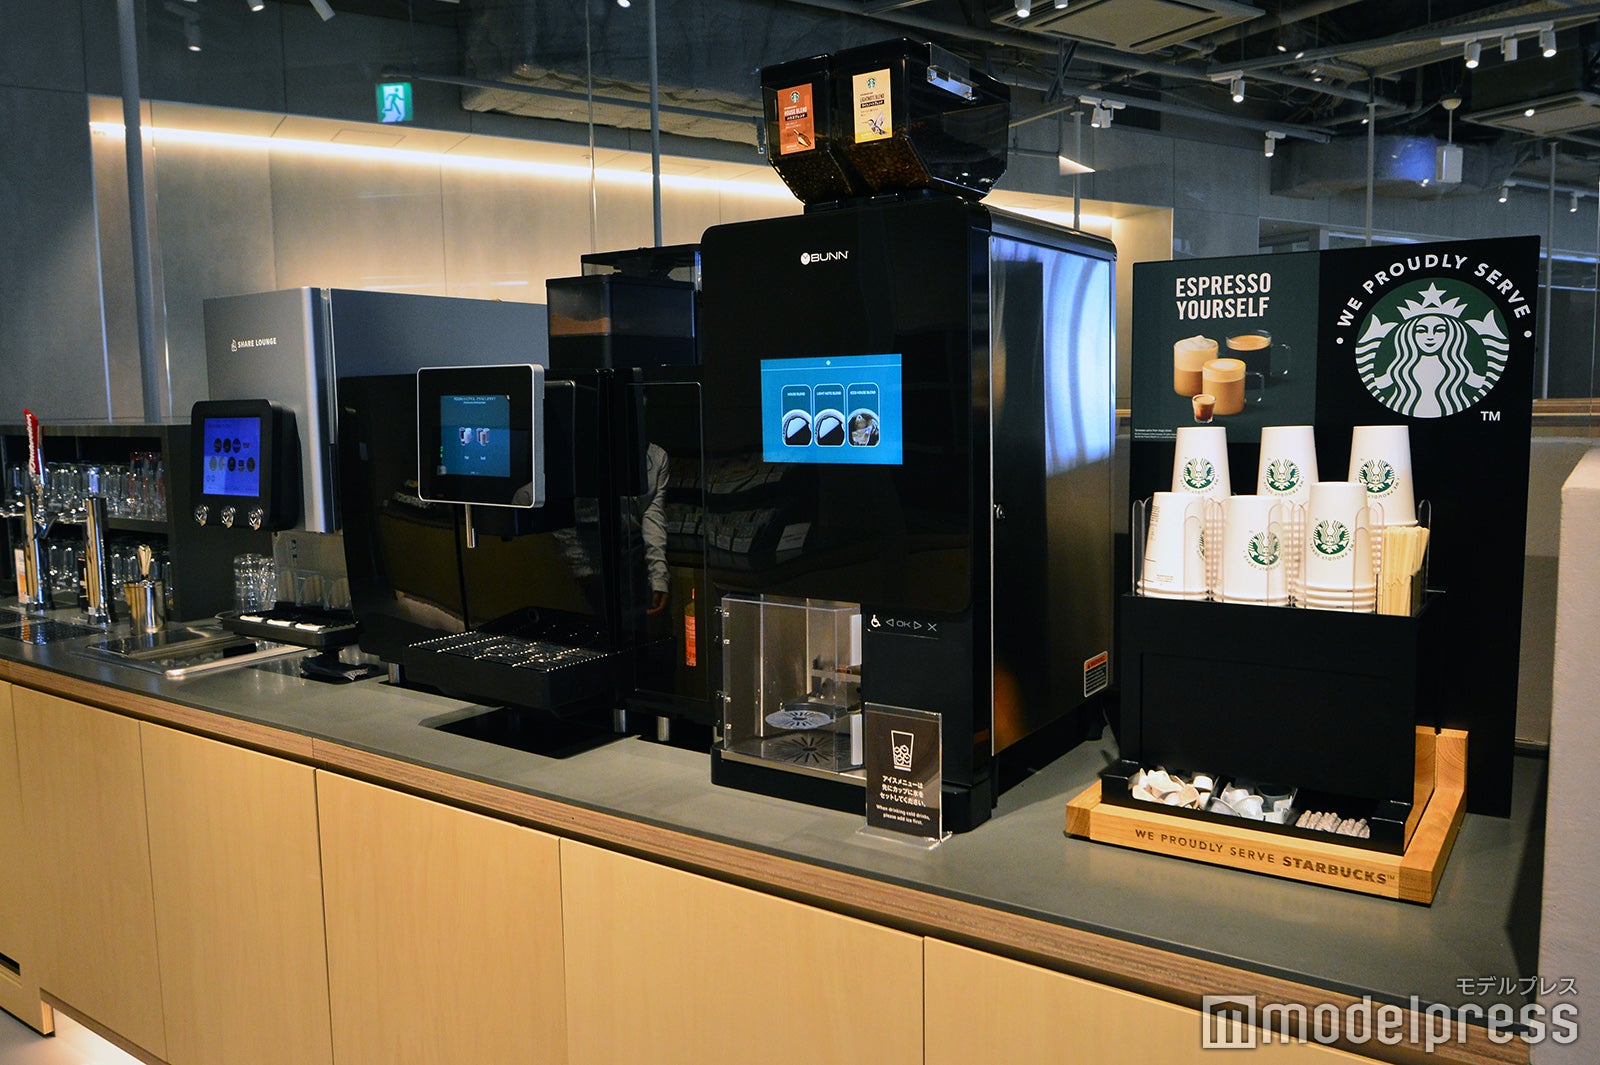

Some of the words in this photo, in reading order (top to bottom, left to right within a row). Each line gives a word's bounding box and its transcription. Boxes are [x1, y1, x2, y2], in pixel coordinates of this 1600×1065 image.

[810, 250, 849, 262] BUNN
[1175, 272, 1271, 298] ESPRESSO
[1337, 297, 1363, 326] WE
[1362, 254, 1468, 295] PROUDLY
[1473, 262, 1532, 319] SERVE
[1176, 296, 1270, 320] YOURSELF
[237, 340, 255, 349] SHARE
[255, 337, 277, 347] LOUNGE
[1480, 411, 1501, 422] TM
[896, 620, 911, 628] OK
[882, 775, 924, 789] アイスメニューは
[1135, 829, 1154, 841] WE
[1161, 834, 1223, 853] PROUDLY
[1230, 846, 1275, 863] SERVE
